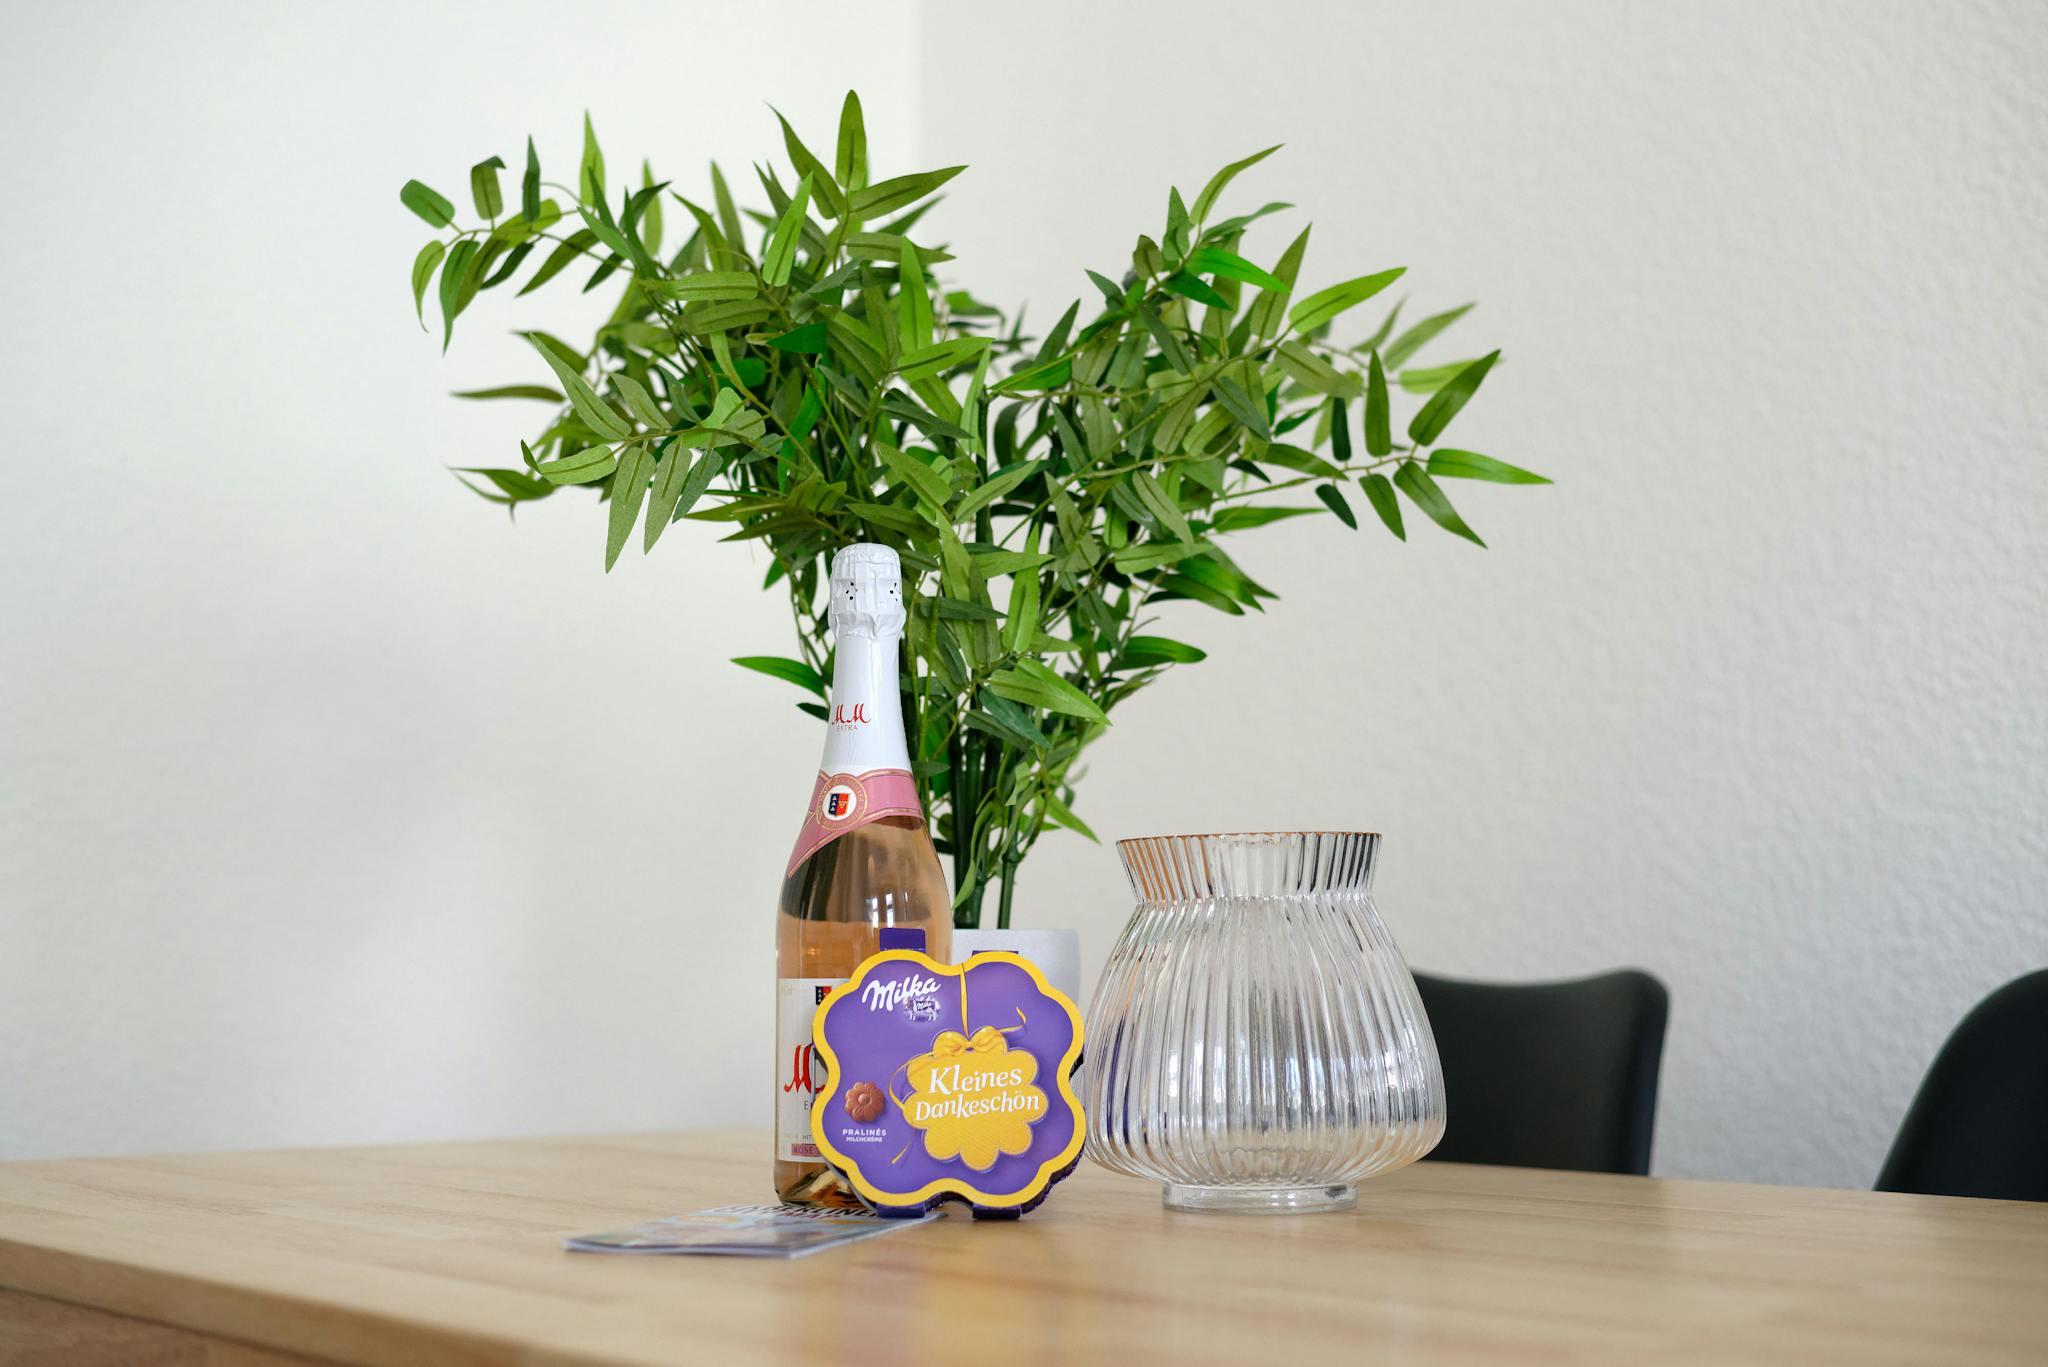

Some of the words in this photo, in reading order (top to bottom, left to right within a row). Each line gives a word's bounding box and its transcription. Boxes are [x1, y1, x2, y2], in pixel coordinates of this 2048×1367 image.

[861, 974, 941, 1011] Milka
[928, 1064, 1022, 1095] Kleines
[915, 1090, 1040, 1121] Dankeschön
[842, 1127, 887, 1137] PRALINÉS
